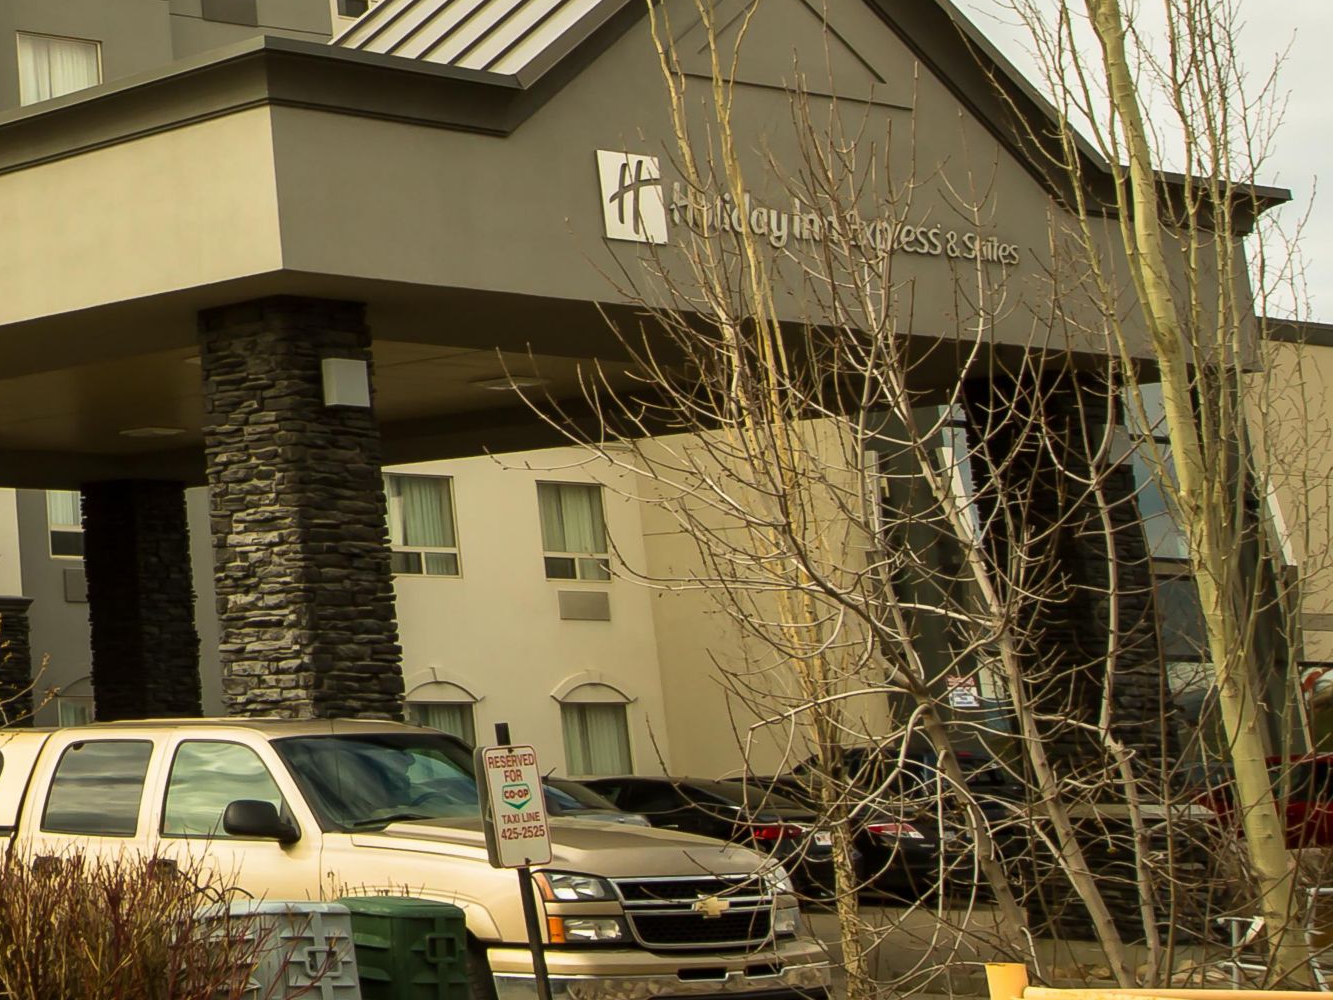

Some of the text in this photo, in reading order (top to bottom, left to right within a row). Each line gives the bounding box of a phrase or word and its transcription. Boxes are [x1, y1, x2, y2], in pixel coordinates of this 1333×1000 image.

[945, 230, 962, 257] &
[488, 753, 535, 769] RESERVED
[504, 769, 523, 782] FOR
[504, 789, 529, 799] CO-OP
[501, 811, 541, 825] TAXI LINE
[501, 825, 545, 840] 425-2525
